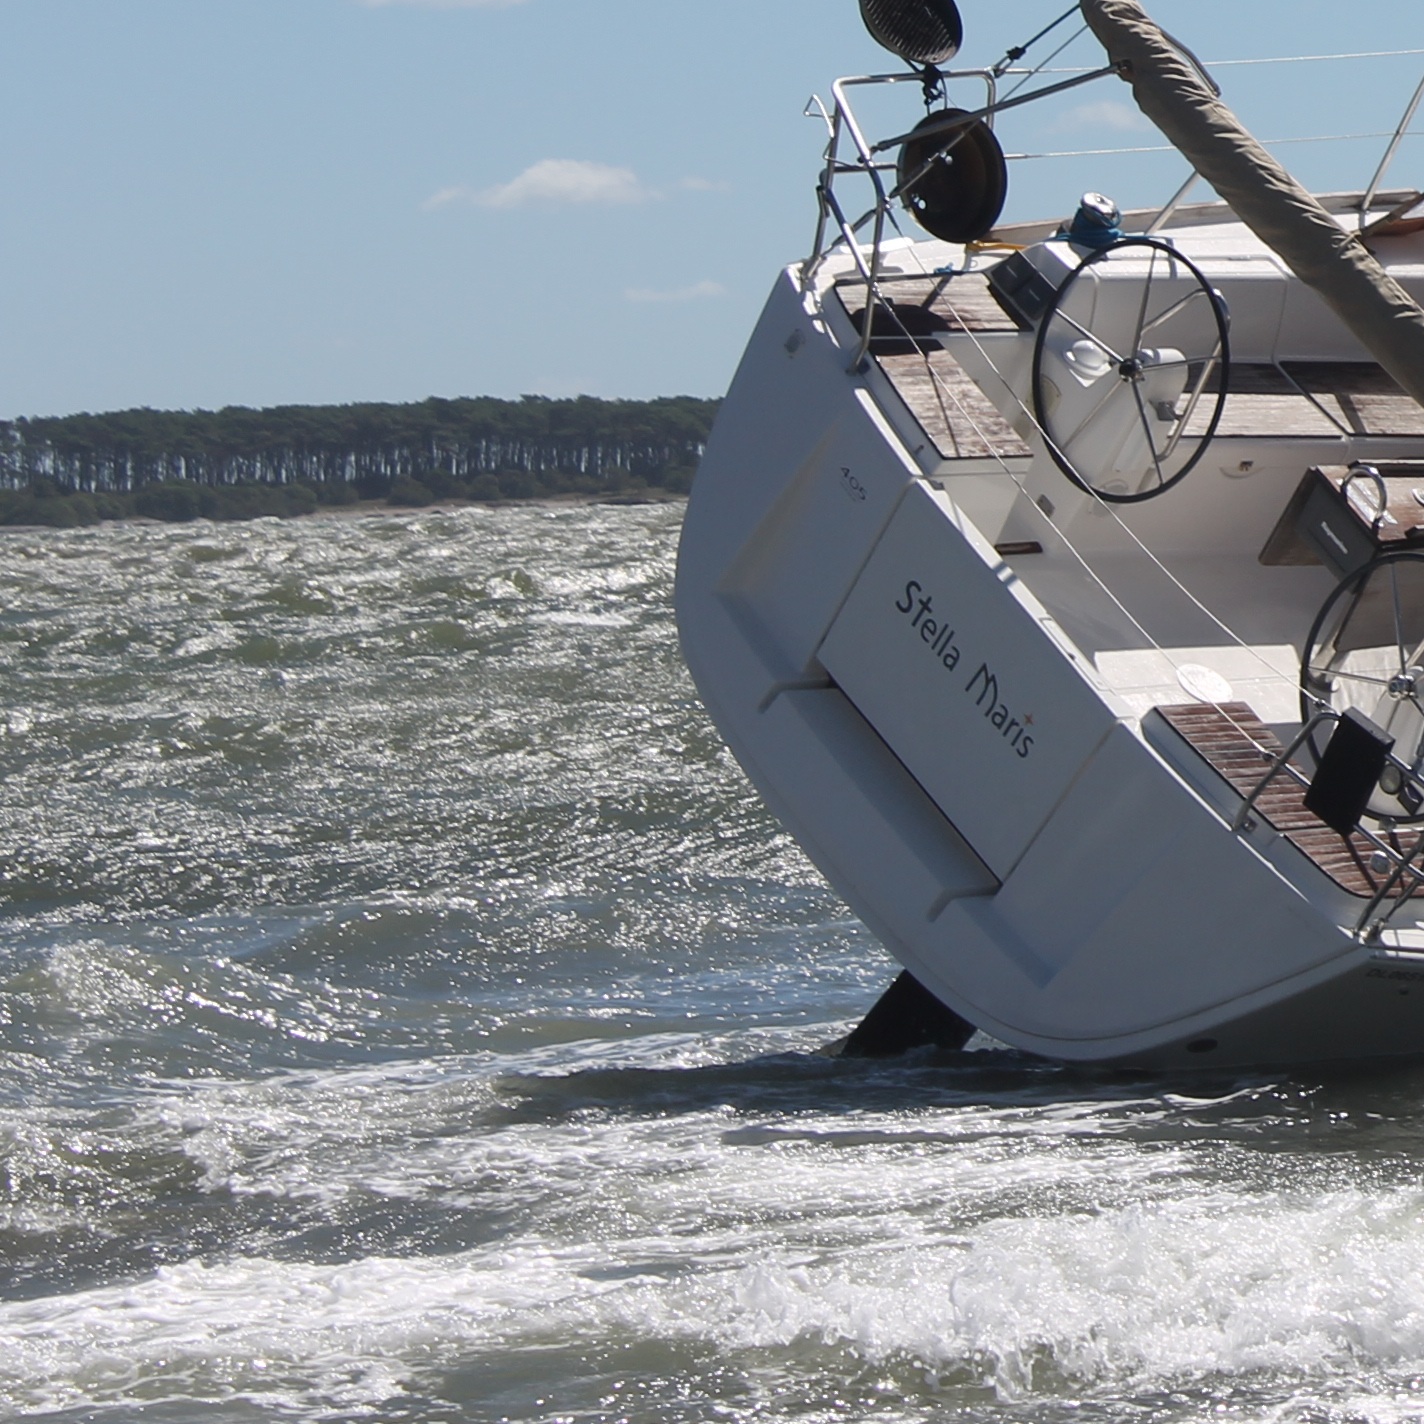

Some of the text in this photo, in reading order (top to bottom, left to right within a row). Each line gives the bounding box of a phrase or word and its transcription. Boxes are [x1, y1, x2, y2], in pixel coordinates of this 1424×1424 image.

[840, 467, 868, 501] 405
[895, 580, 1035, 758] Stella Maris
